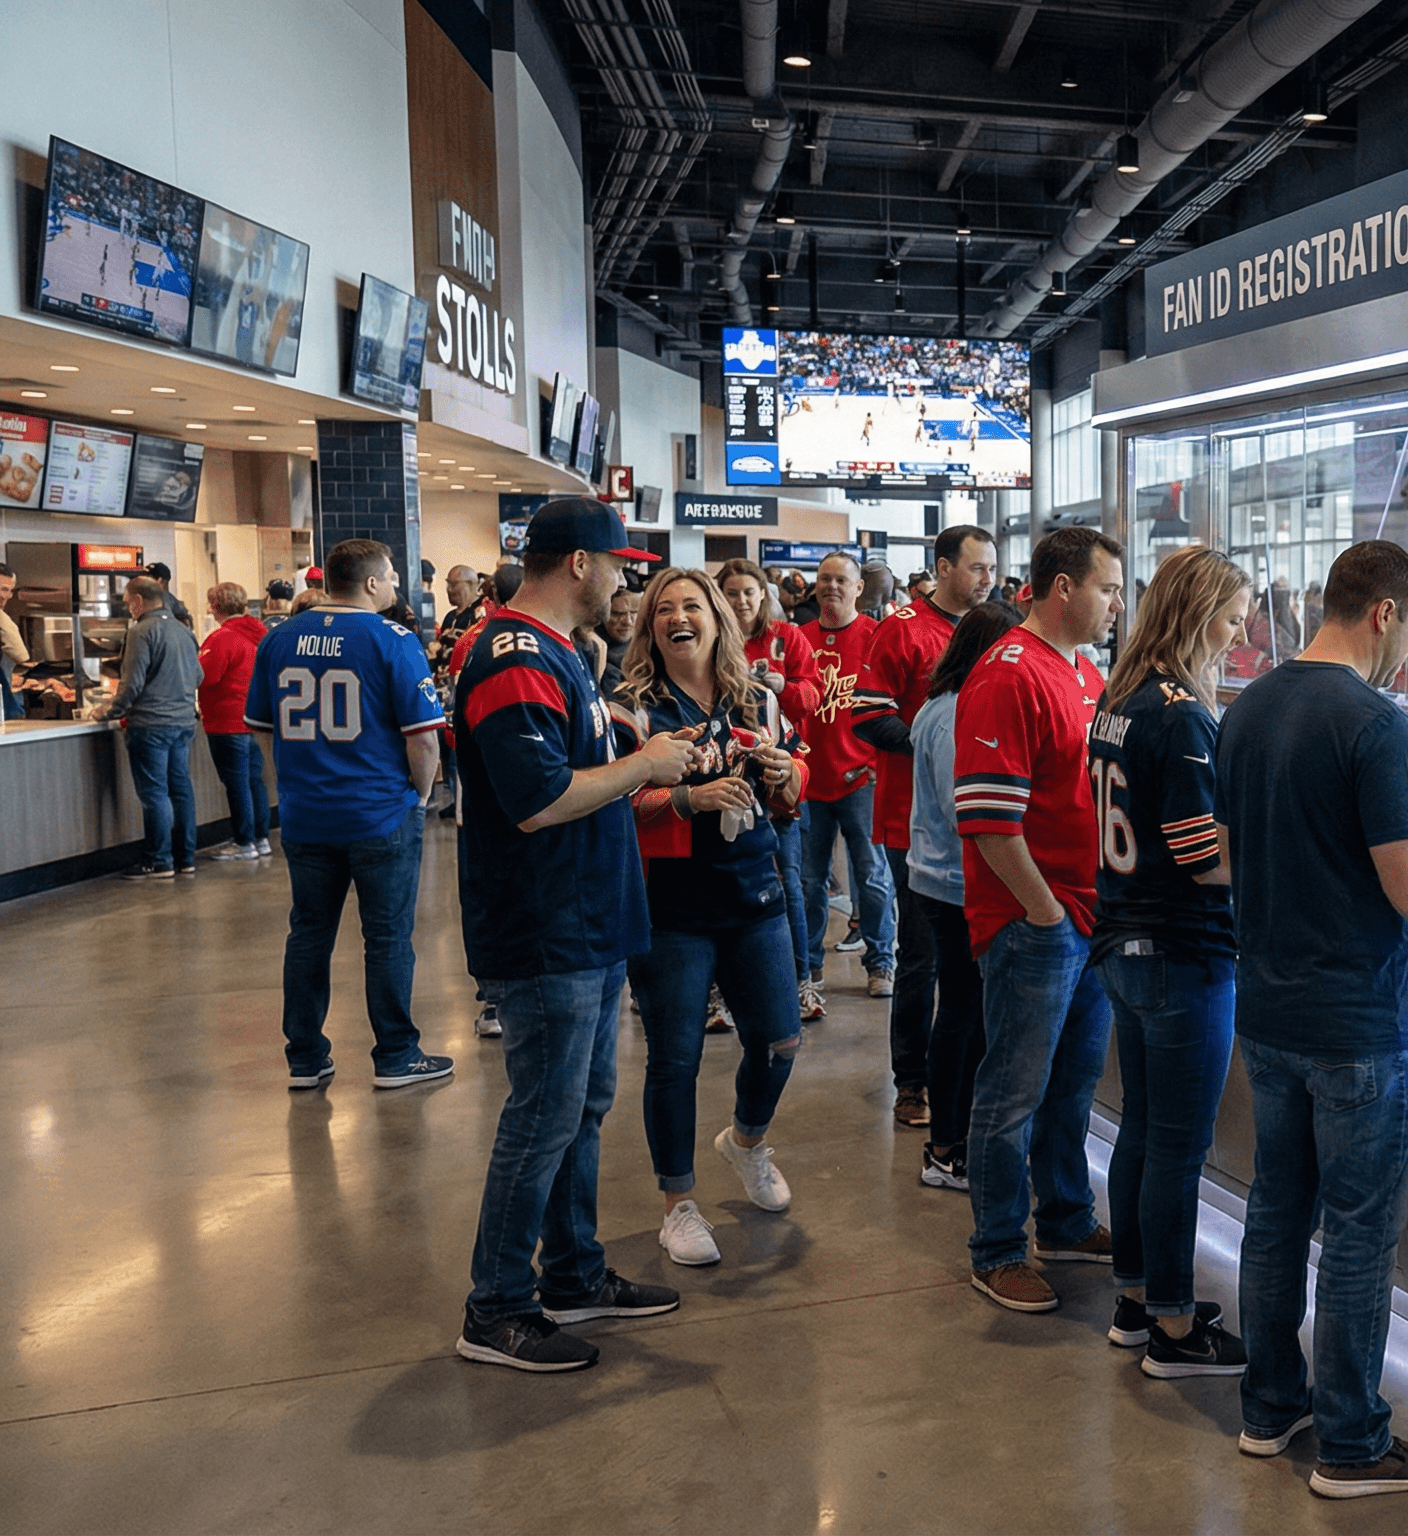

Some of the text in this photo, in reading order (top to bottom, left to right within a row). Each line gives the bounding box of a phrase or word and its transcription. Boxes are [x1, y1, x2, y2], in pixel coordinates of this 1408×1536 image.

[436, 274, 516, 395] STOLLS
[1163, 277, 1203, 333] FAN
[1209, 266, 1231, 320] ID
[491, 631, 540, 659] 22
[277, 666, 363, 742] 20
[1091, 756, 1138, 875] 16
